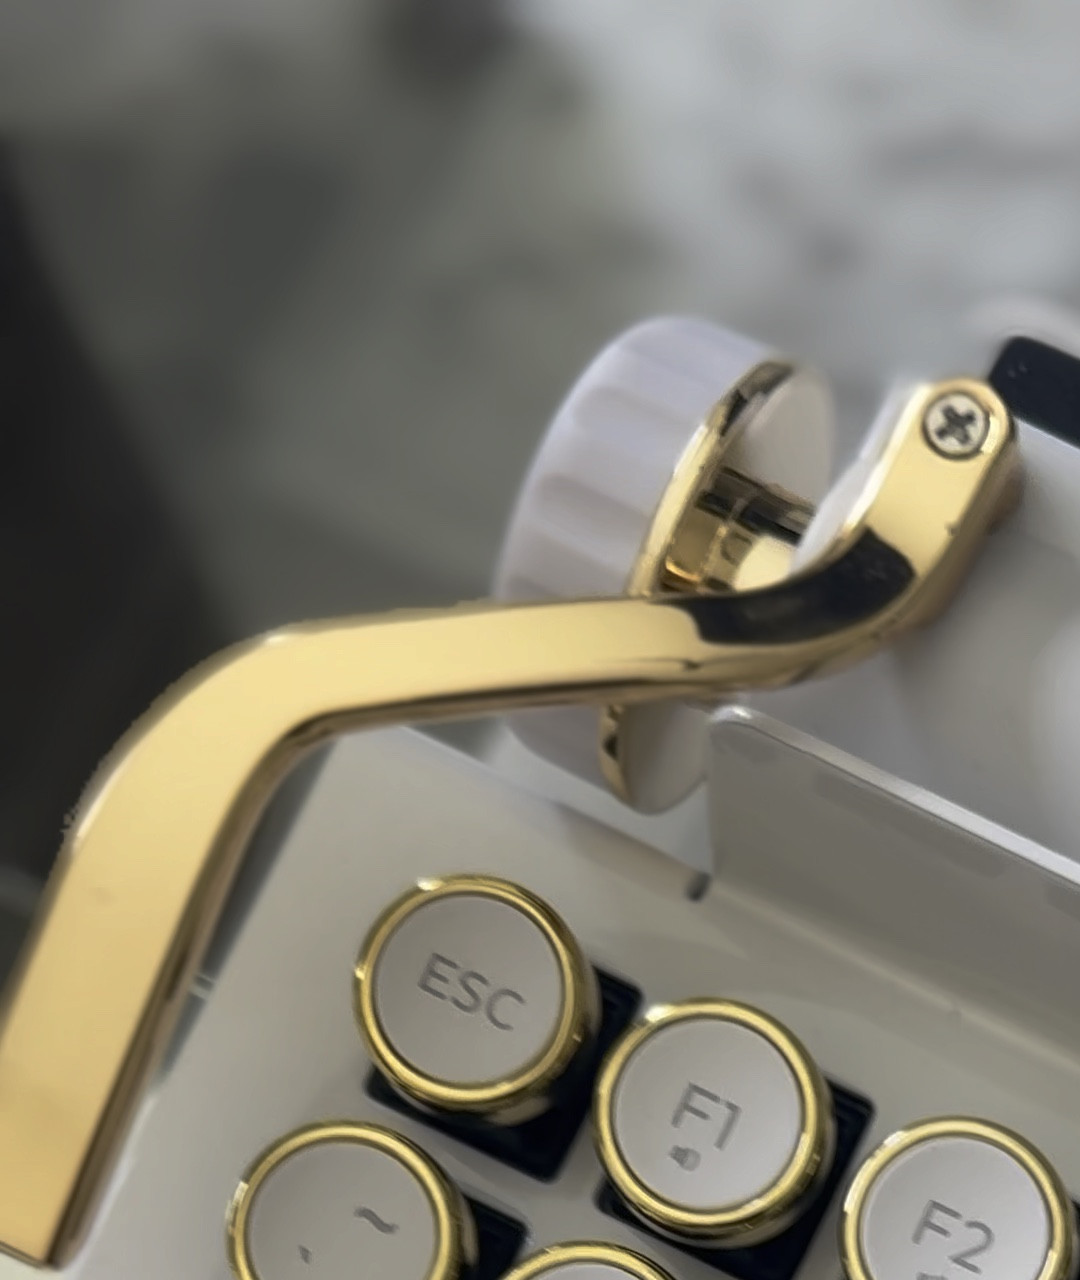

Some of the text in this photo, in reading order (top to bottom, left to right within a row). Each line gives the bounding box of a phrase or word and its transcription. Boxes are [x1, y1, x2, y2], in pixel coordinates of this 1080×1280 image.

[415, 953, 527, 1032] ESC
[670, 1082, 743, 1152] F1
[911, 1199, 996, 1276] F2
